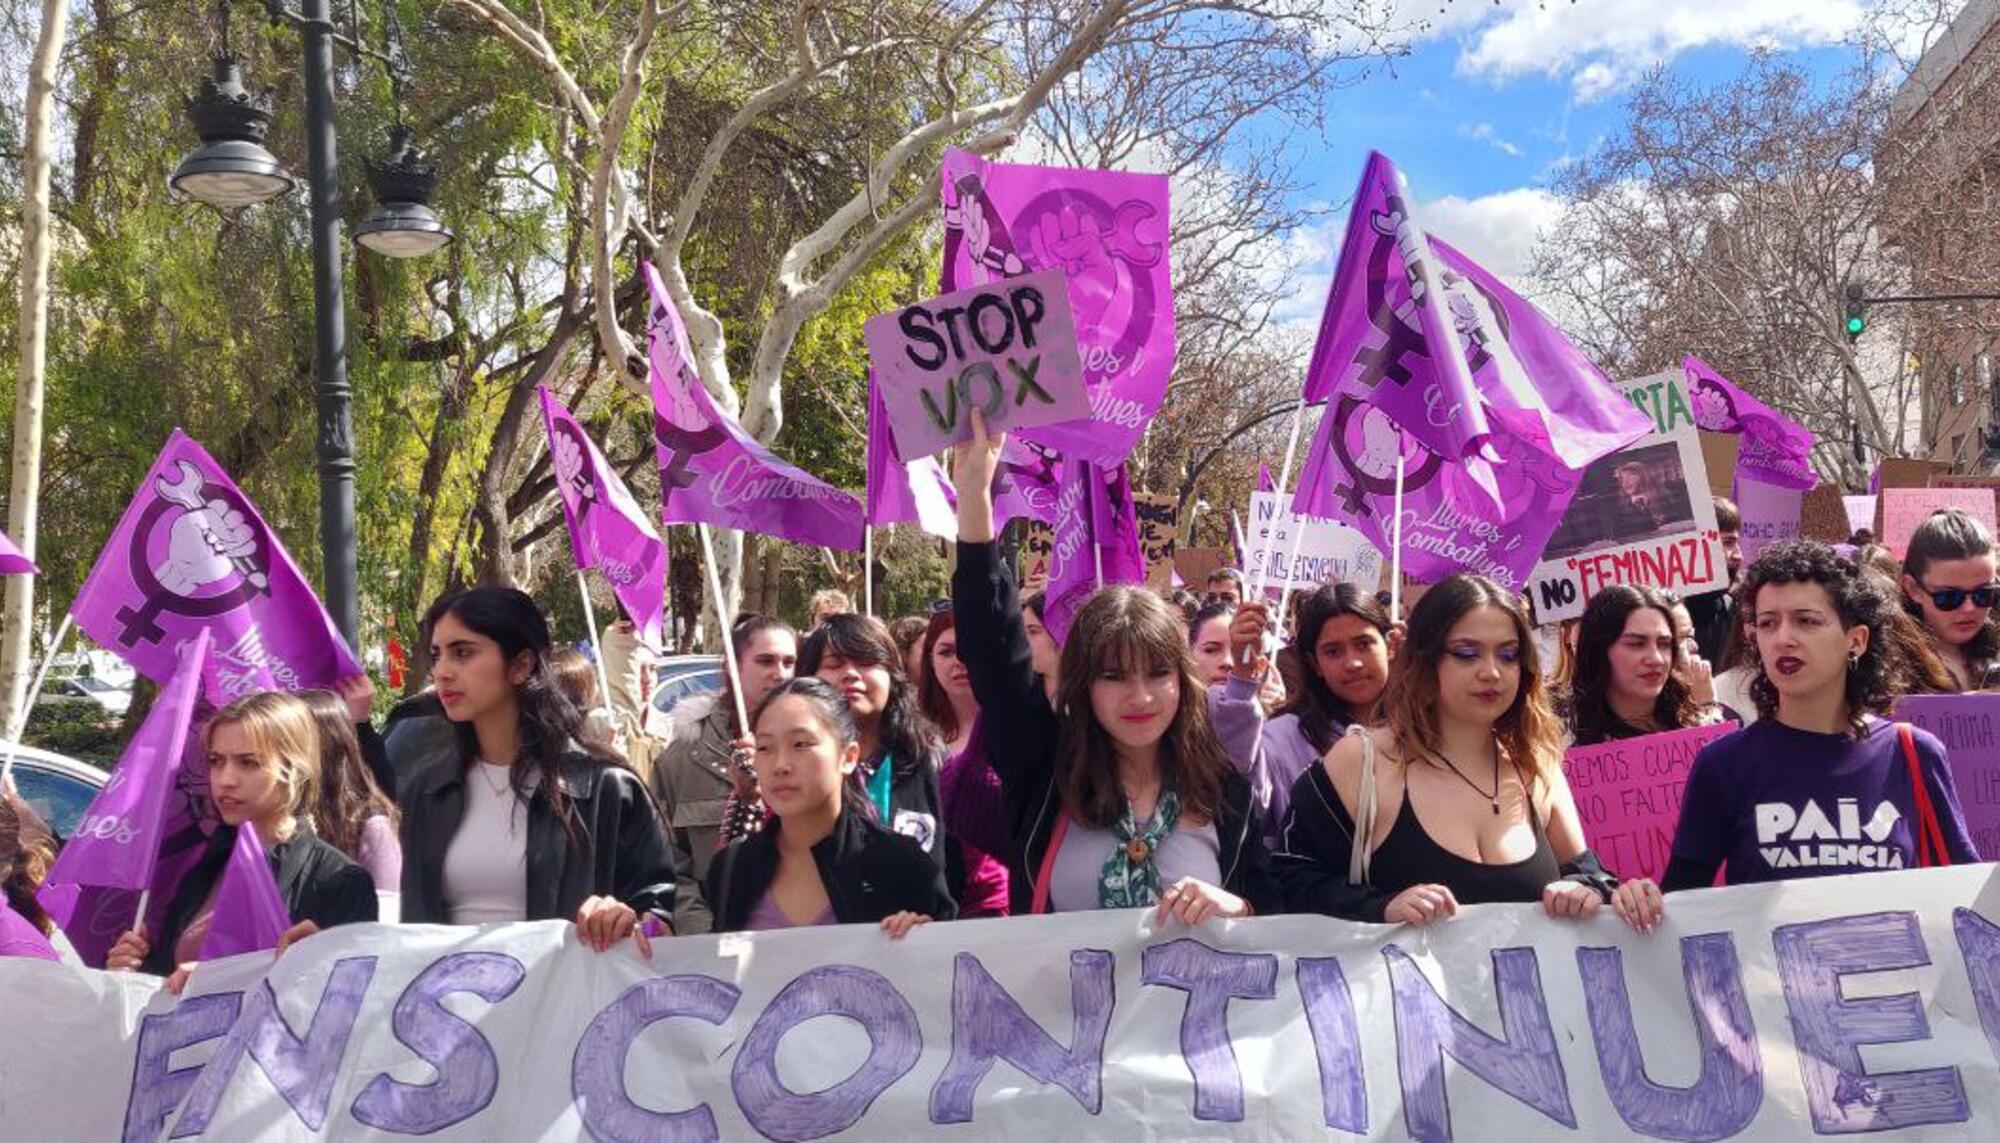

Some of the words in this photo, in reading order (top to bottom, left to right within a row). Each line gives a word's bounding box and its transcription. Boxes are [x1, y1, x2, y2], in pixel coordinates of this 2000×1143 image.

[898, 286, 1045, 371] STOP
[920, 354, 1055, 434] VOX
[1381, 511, 1520, 588] Combatives
[1416, 499, 1505, 542] Lliures
[1540, 578, 1577, 610] NO
[122, 952, 526, 1143] ENS
